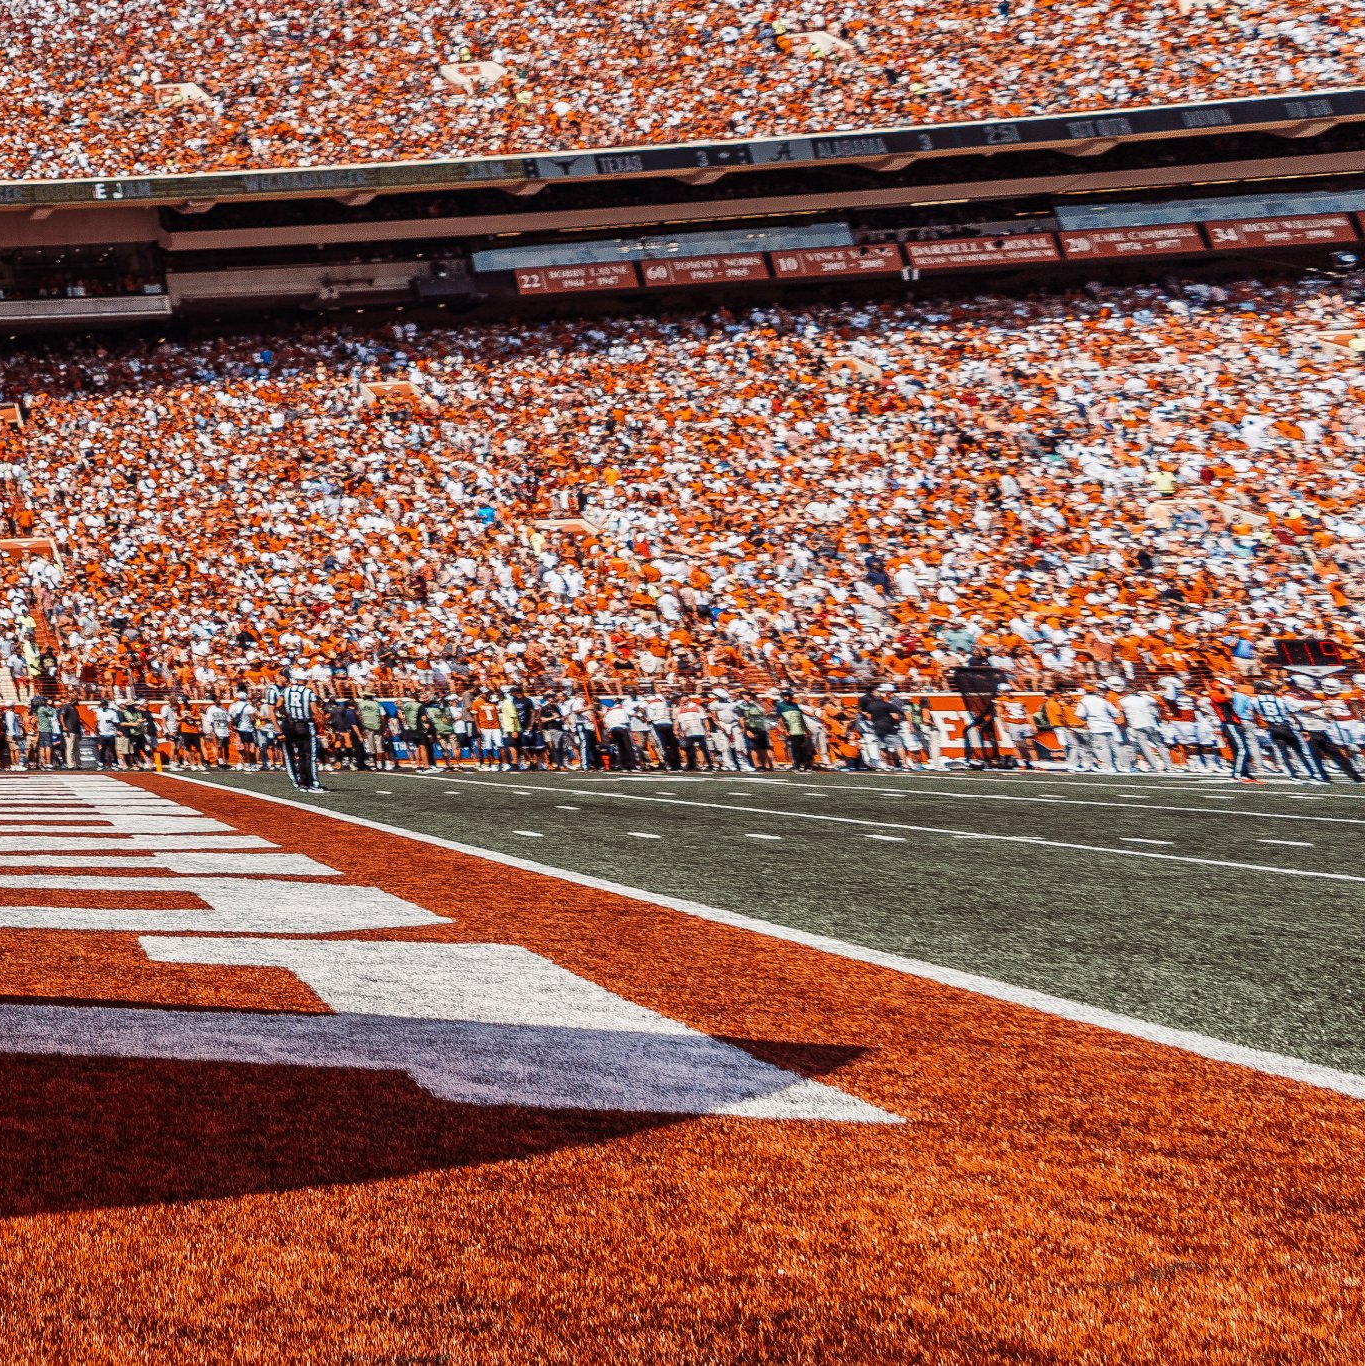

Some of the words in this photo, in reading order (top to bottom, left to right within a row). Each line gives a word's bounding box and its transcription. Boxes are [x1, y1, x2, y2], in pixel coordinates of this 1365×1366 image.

[598, 155, 643, 173] TEXAS
[695, 150, 709, 167] 3
[1211, 227, 1239, 242] 34
[910, 242, 983, 257] DARRELL
[1064, 238, 1091, 253] 20
[777, 256, 799, 272] 10
[804, 251, 847, 262] VINCE
[646, 266, 668, 280] 60
[520, 274, 542, 289] 22
[1281, 641, 1344, 667] 1:19
[291, 693, 302, 708] R
